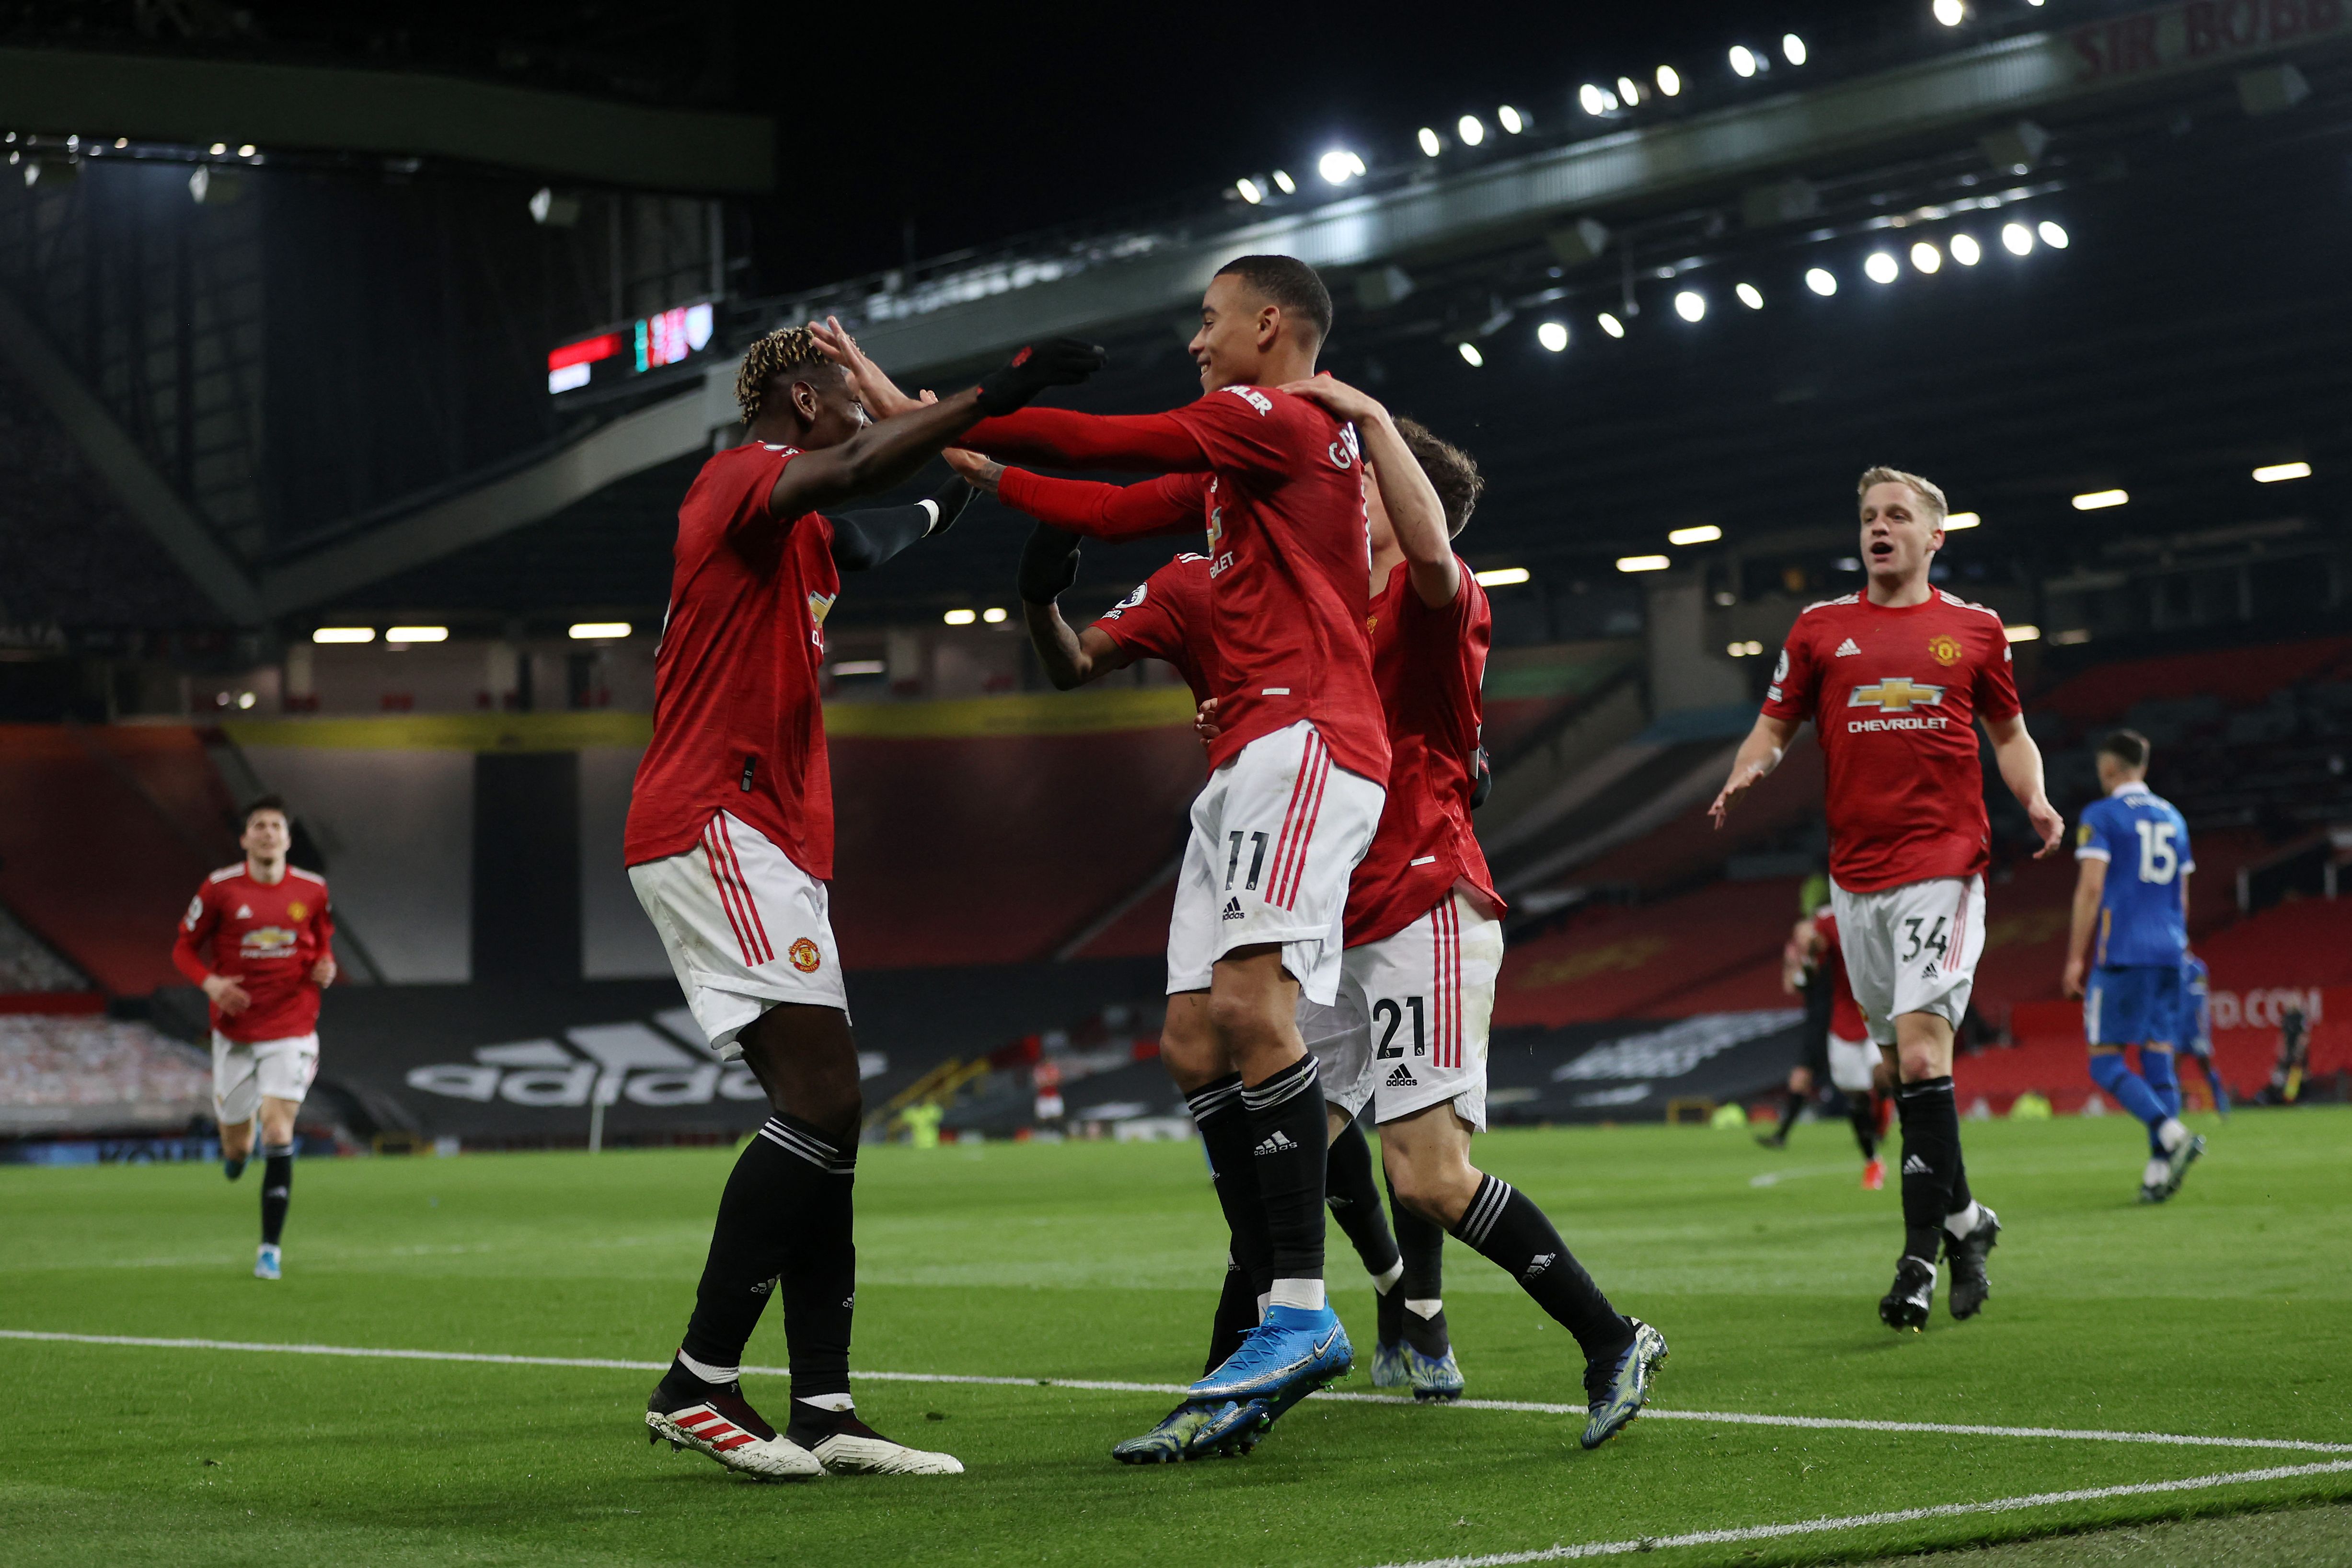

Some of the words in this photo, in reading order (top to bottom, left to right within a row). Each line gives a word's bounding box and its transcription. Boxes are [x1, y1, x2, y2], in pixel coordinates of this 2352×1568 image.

[1848, 717, 1948, 734] CHEVROLET
[1225, 831, 1270, 891] 11
[2135, 819, 2178, 885] 15
[1902, 916, 1947, 962] 34
[1373, 996, 1425, 1060] 21
[1386, 1076, 1418, 1086] adidas
[1254, 1142, 1298, 1156] adidas
